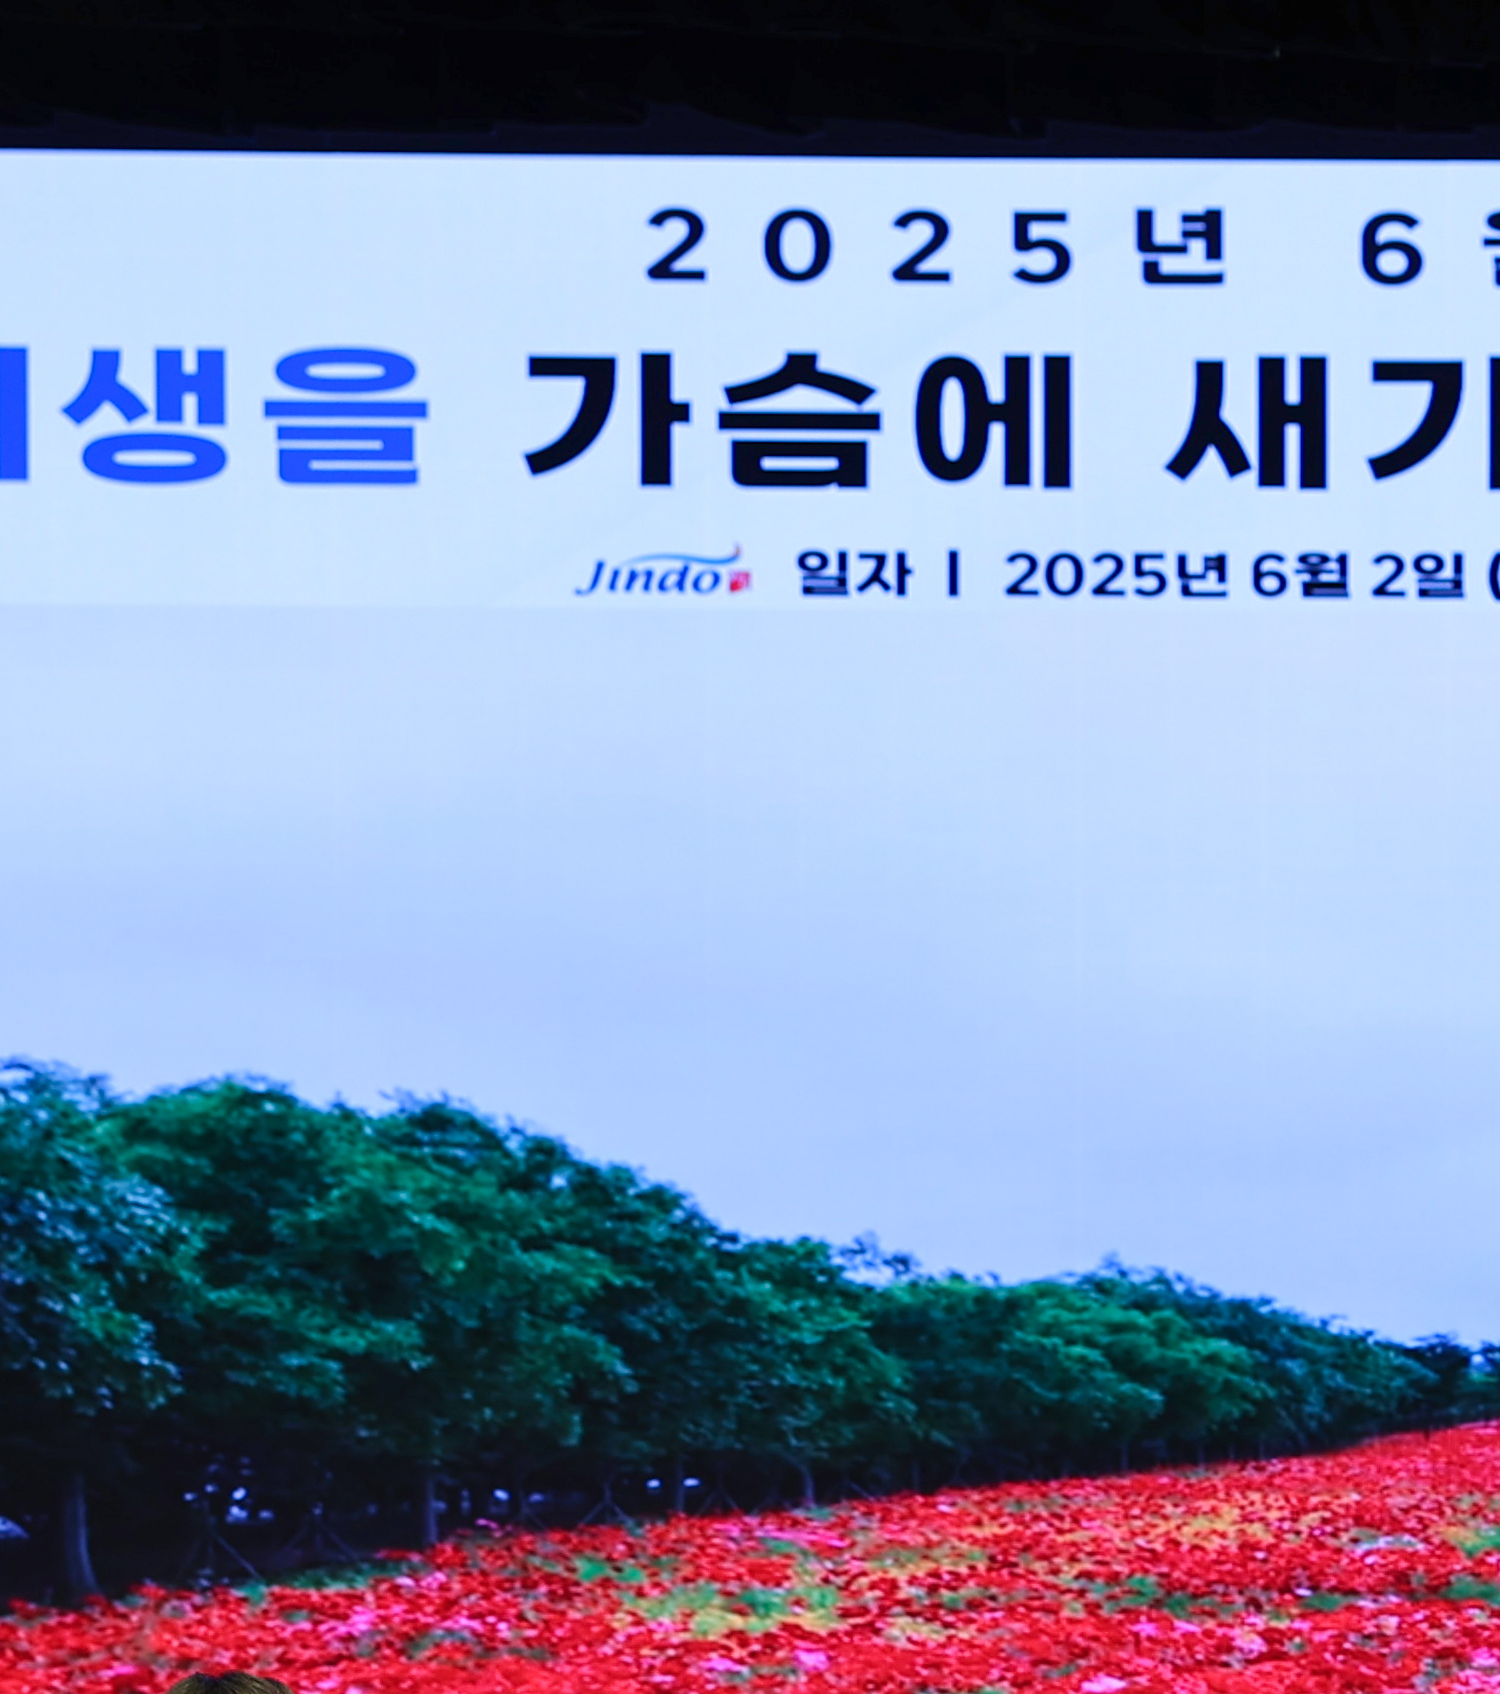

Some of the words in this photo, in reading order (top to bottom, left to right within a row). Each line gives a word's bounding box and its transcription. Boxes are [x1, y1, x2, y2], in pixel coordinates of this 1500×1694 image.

[645, 206, 1225, 285] 2025년
[522, 349, 1073, 490] 가슴에
[574, 556, 724, 597] Jindo
[796, 549, 913, 597] 일자
[1003, 551, 1229, 598] 2025년
[1251, 552, 1350, 599] 6월
[1370, 552, 1465, 599] 2일
